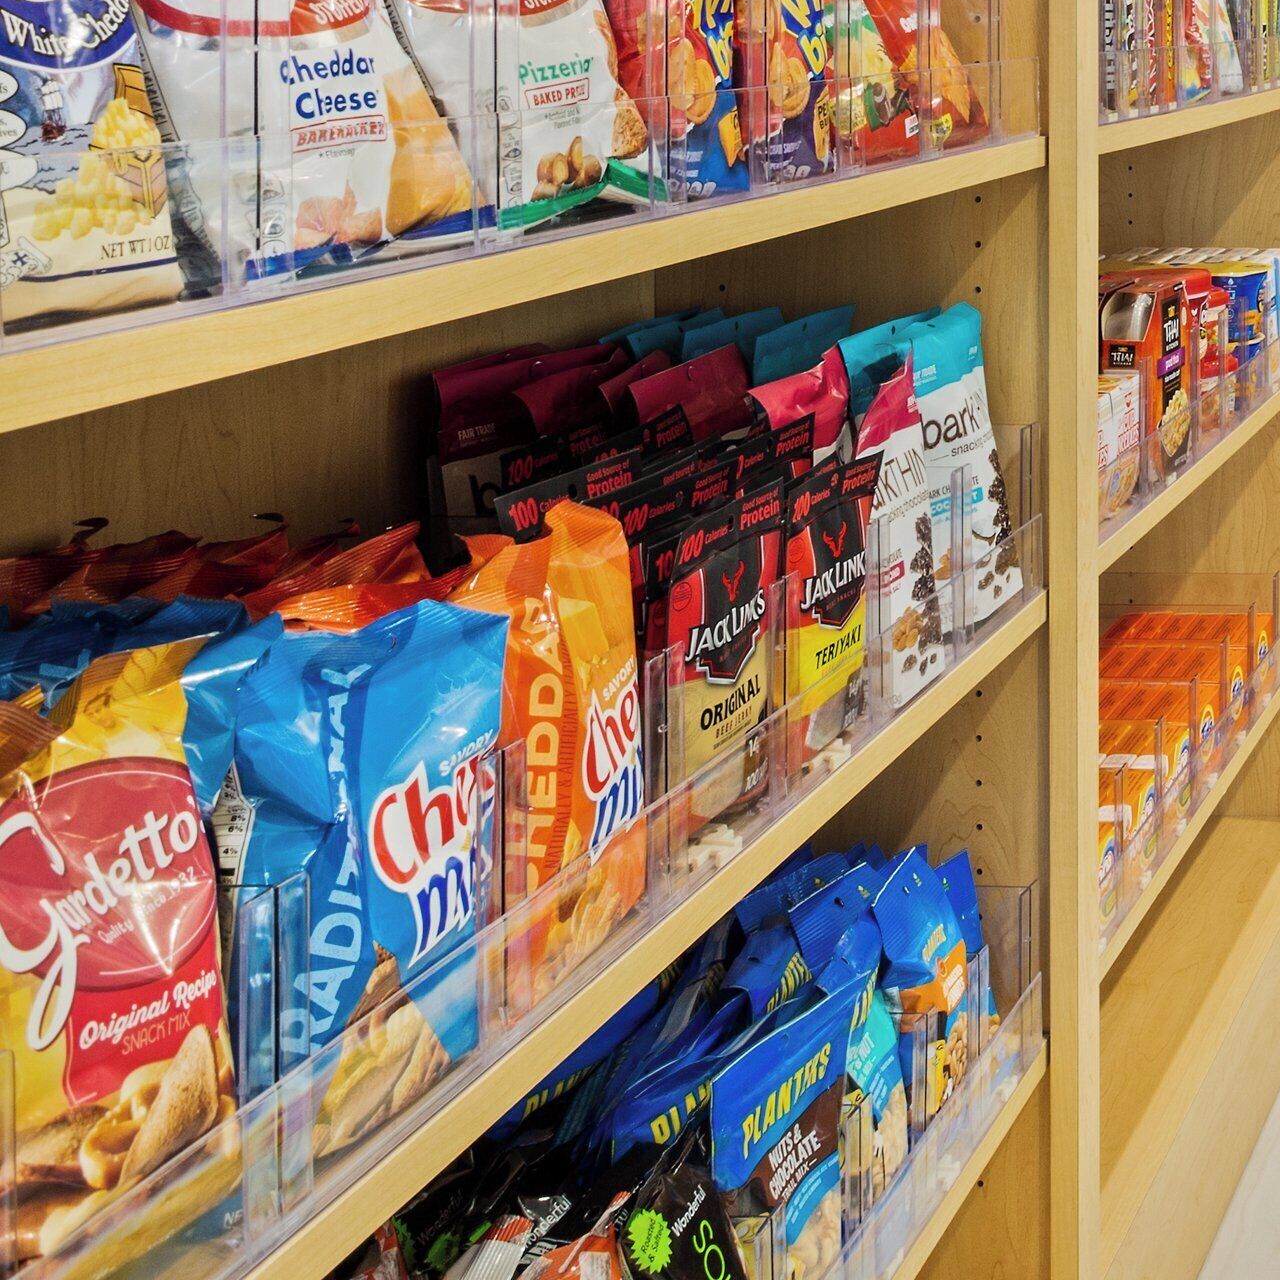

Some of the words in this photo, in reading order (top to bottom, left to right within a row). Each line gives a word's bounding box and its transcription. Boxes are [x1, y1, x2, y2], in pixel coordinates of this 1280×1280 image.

[1, 8, 69, 58] White
[279, 47, 376, 86] Cheddar
[518, 53, 591, 85] Pizzeria
[533, 89, 563, 107] BAKED
[101, 242, 125, 260] NET
[128, 239, 147, 256] WT
[154, 235, 170, 252] OZ
[457, 426, 475, 441] FAIR
[775, 431, 810, 457] Protein
[586, 468, 601, 483] Good
[601, 462, 622, 478] Source
[586, 470, 634, 499] Protein
[691, 478, 729, 507] Protein
[842, 469, 876, 495] Protein
[509, 497, 539, 532] 100
[623, 503, 649, 536] 100
[740, 499, 781, 531] Protein
[742, 499, 754, 512] Good
[754, 492, 771, 508] Source
[793, 491, 811, 523] 100
[810, 488, 831, 505] Calories
[655, 548, 674, 583] 10
[678, 530, 704, 566] 100
[705, 525, 729, 545] Calories
[800, 566, 837, 611] JACK
[835, 552, 867, 590] LINK
[685, 616, 733, 663] JACK
[815, 624, 862, 670] TERIYAKI
[602, 655, 637, 701] SAVORY
[700, 673, 761, 732] ORIGINAL
[440, 728, 494, 778] SAVORY
[513, 597, 564, 872] HEDDAR
[586, 680, 640, 795] Che
[546, 789, 567, 870] NATURALLY
[558, 690, 578, 776] ARTIFICIALLY
[591, 744, 644, 849] mi
[166, 865, 196, 900] 1932
[418, 845, 482, 953] mi
[0, 798, 206, 1051] Gardetto'
[79, 991, 170, 1050] Original
[172, 969, 217, 1011] Recipe
[121, 1020, 166, 1055] SNACK
[167, 1010, 191, 1035] MIX
[741, 1041, 832, 1160] PLANTERS
[768, 1134, 794, 1171] NUTS
[793, 1122, 803, 1142] &
[769, 1129, 822, 1201] CHOCOLATE
[671, 1183, 708, 1238] Wonderful
